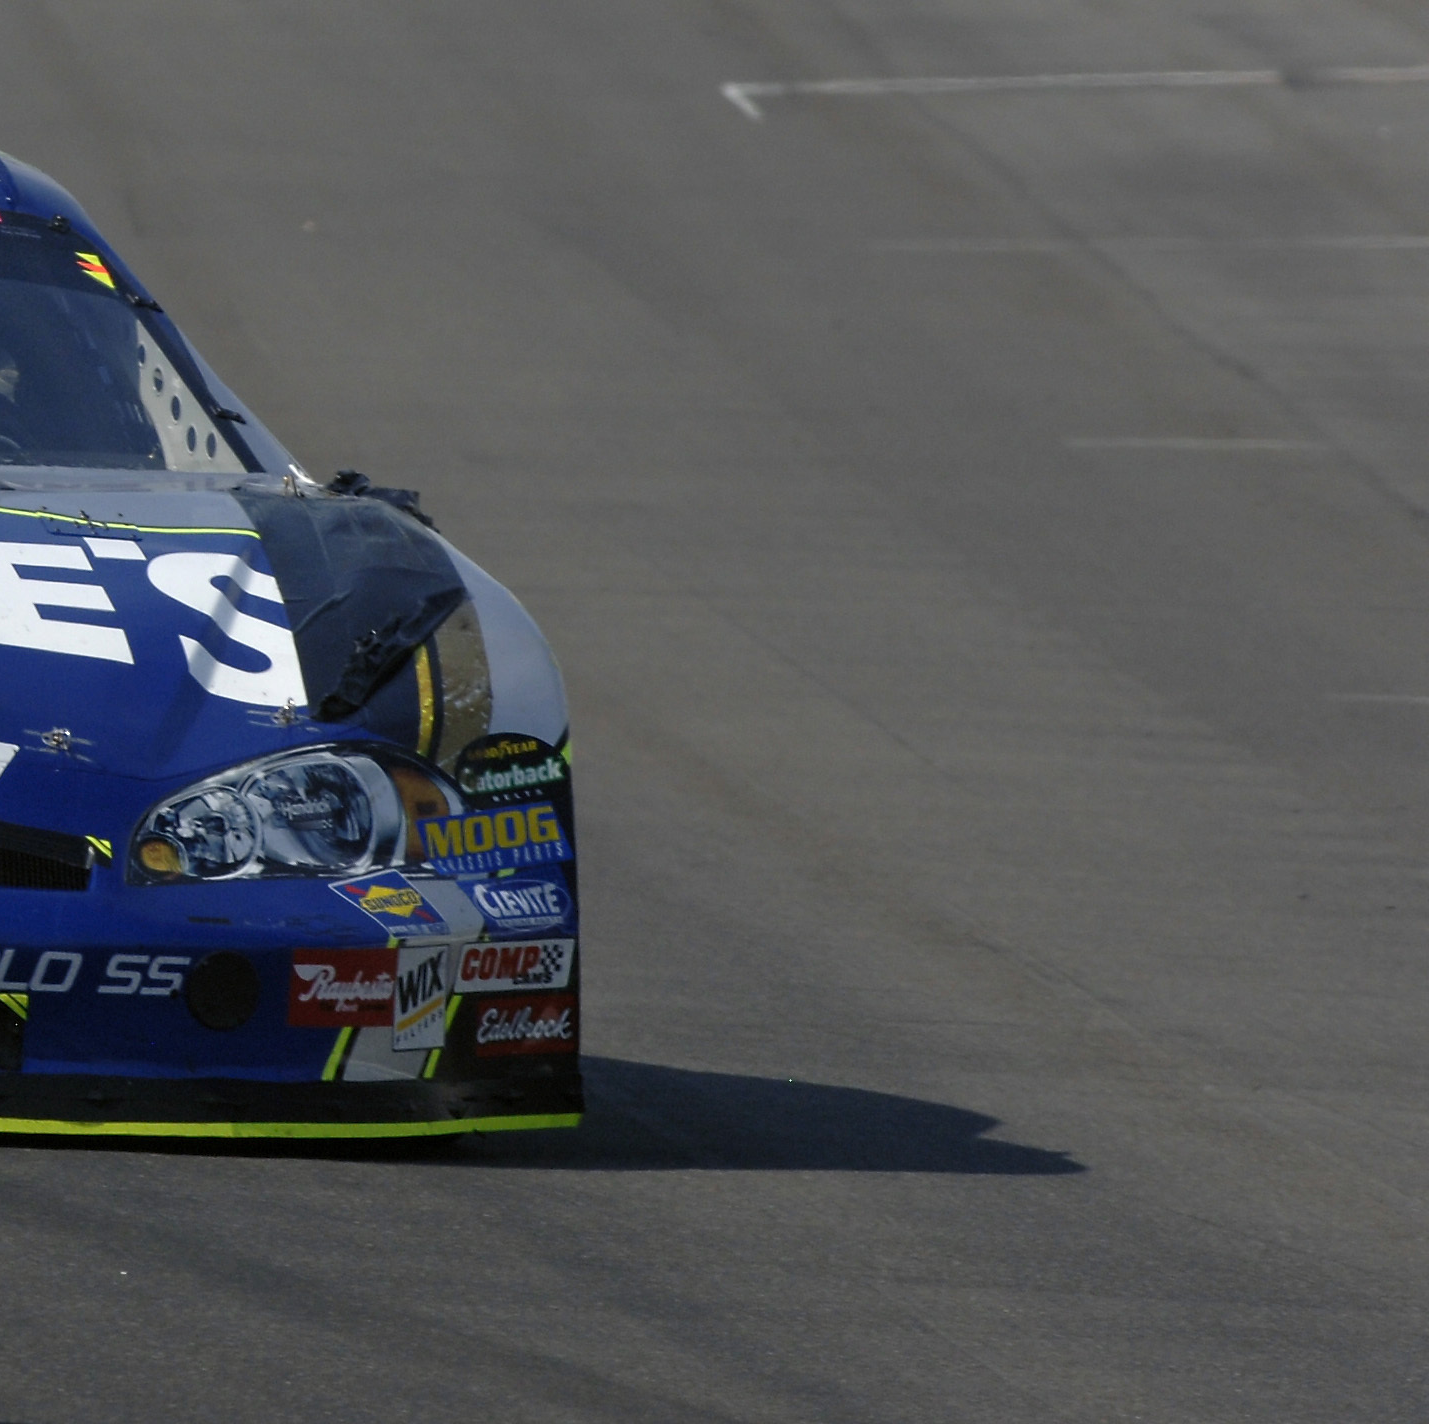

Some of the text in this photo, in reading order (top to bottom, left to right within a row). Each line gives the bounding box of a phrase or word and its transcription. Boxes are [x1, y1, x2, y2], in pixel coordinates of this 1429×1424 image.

[425, 805, 561, 859] MOOG
[512, 842, 565, 864] PARTS
[363, 890, 419, 911] SUNOCO
[475, 884, 561, 918] CLEVITE
[96, 954, 192, 997] SS
[460, 945, 544, 982] COMP
[398, 951, 444, 1015] WIX
[476, 1006, 573, 1044] Edelbrock
